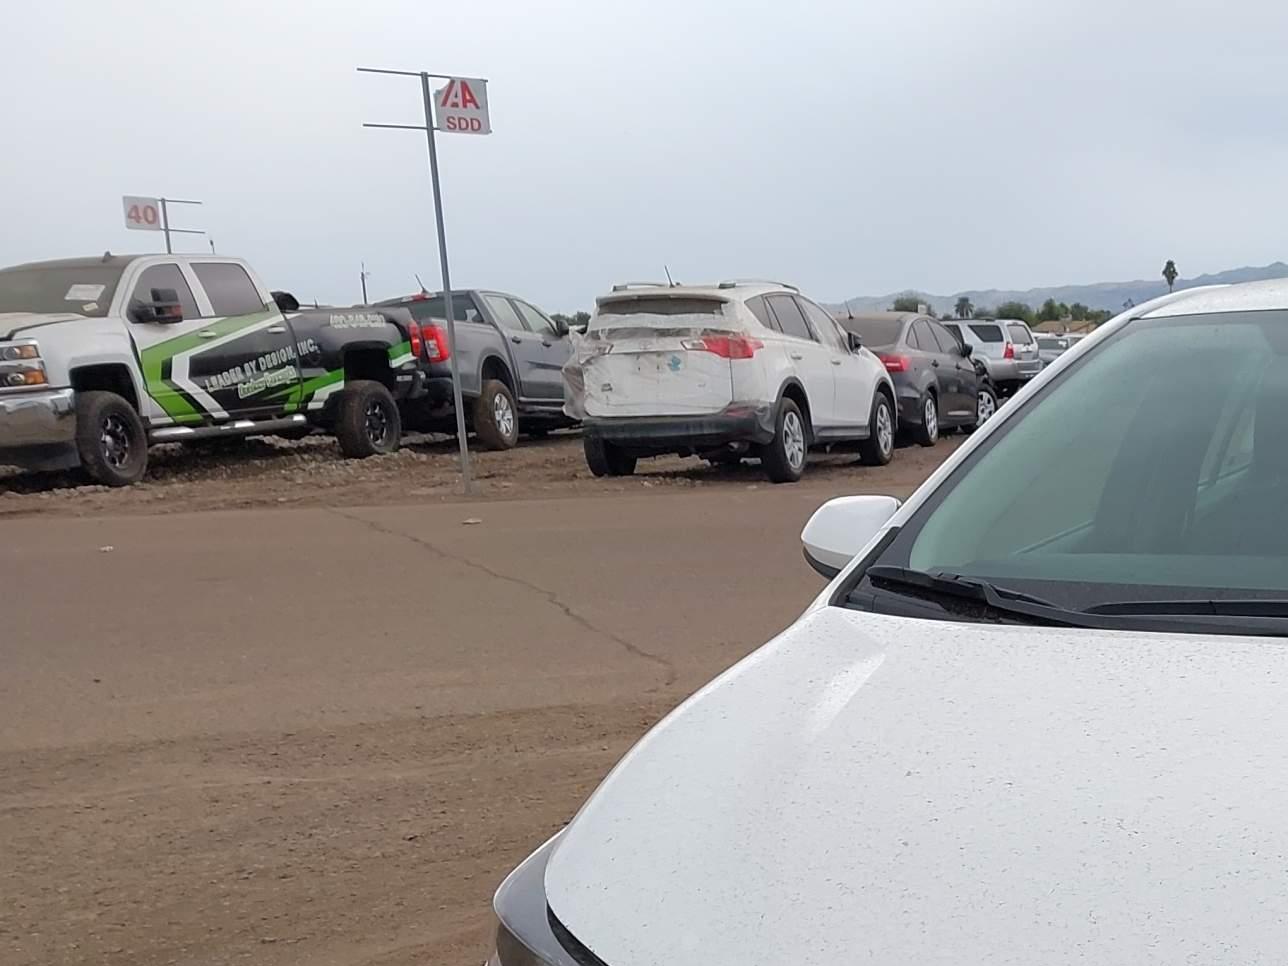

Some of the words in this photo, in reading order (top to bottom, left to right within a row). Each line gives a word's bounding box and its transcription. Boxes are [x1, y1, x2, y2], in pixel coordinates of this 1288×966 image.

[446, 116, 481, 132] SDD
[127, 204, 157, 224] 40
[244, 359, 257, 377] BY
